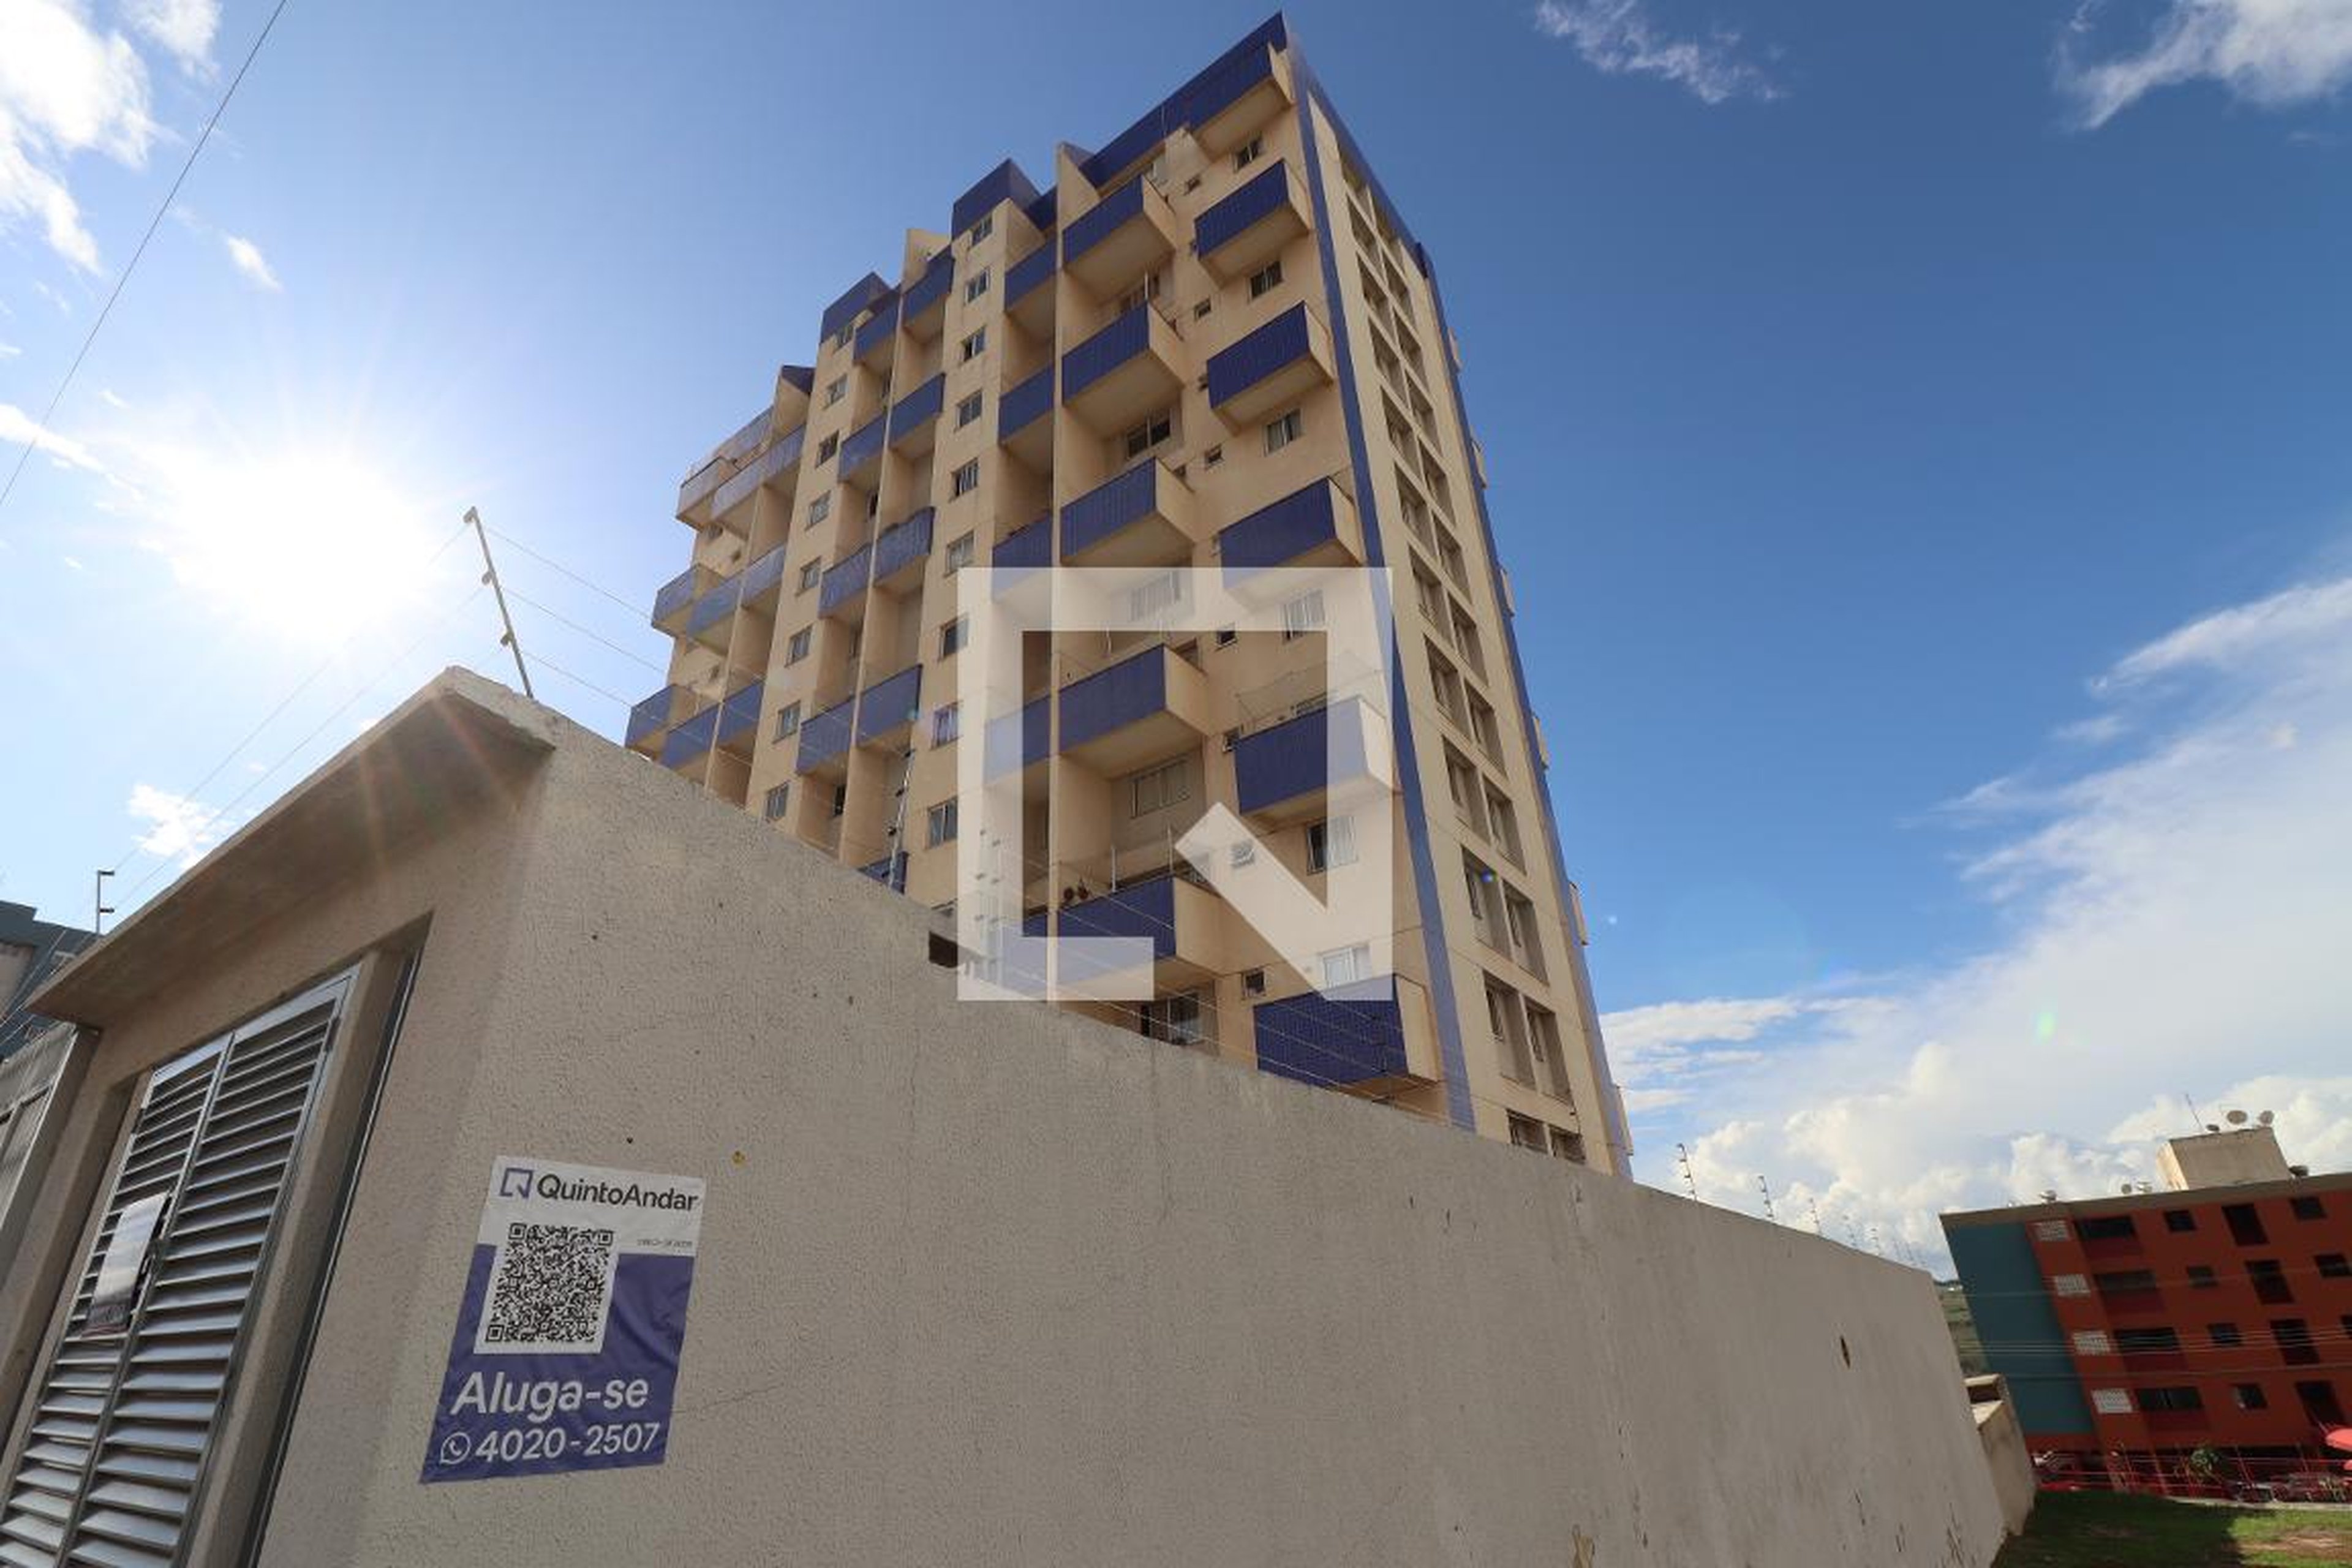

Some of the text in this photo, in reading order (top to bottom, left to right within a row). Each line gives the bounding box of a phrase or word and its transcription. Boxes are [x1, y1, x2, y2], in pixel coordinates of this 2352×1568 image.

[537, 1174, 698, 1211] QuintoAndar
[450, 1371, 649, 1422] Aluga-se
[475, 1422, 660, 1462] 4020-2507
